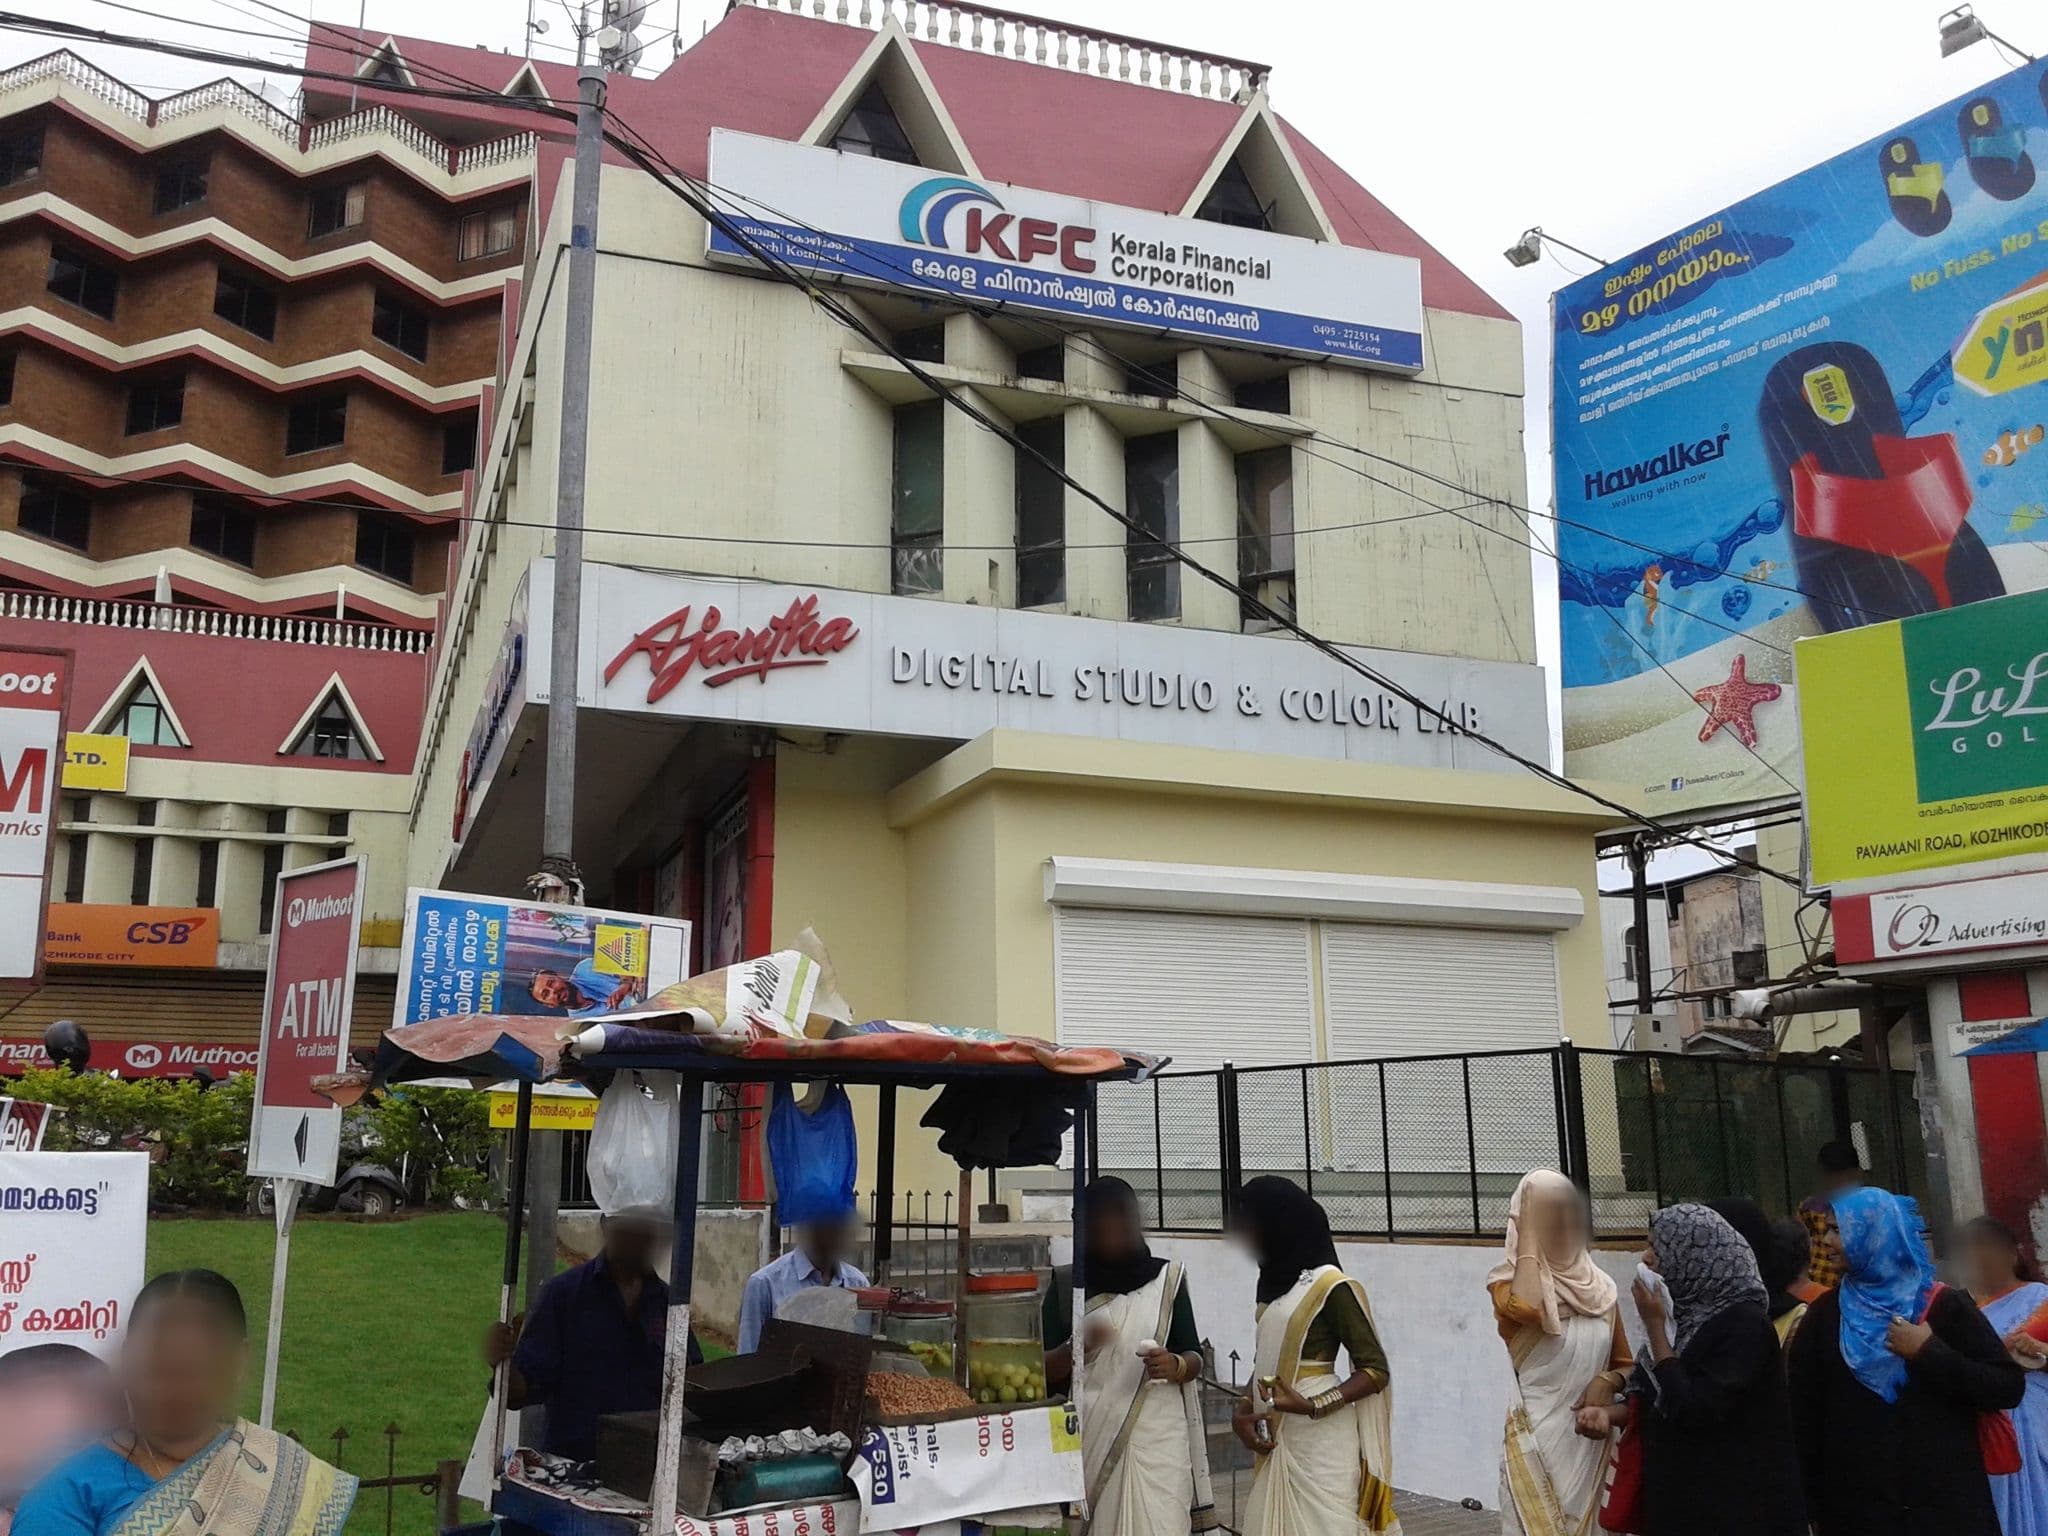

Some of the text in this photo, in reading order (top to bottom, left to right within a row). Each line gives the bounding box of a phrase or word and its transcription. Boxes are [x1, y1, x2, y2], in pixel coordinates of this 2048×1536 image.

[966, 207, 1097, 274] KFC
[1111, 233, 1271, 280] Kerala Financial
[1657, 220, 1723, 266] പോലെ
[912, 258, 977, 288] കേരള
[1111, 256, 1235, 296] Corporation
[1910, 271, 1940, 293] No
[2001, 231, 2033, 257] No
[1312, 325, 1335, 336] 0495
[1581, 303, 1620, 333] മഴ
[1324, 339, 1381, 355] www.kfc.org
[1982, 320, 2046, 380] yn
[1584, 433, 1730, 500] Hawalker
[1610, 471, 1707, 509] walking with now
[604, 593, 860, 704] Ajantha
[892, 645, 1483, 736] DIGITAL STUDIO & COLOR LAB
[1924, 652, 2048, 731] LuL
[1952, 726, 2036, 753] GOL
[64, 752, 107, 766] LTD.
[1856, 840, 1921, 859] PAVAMANI
[1925, 834, 1966, 851] ROAD,
[305, 892, 354, 923] Muthoot
[47, 922, 192, 945] Bank CSB
[1948, 916, 2046, 942] Advertising
[45, 951, 136, 961] ZHIKODE CITY
[622, 931, 632, 971] Asianet
[277, 977, 342, 1040] ATM
[168, 1045, 258, 1065] Muthoo
[296, 1042, 337, 1058] For all banks
[22, 1300, 118, 1339] കമ്മിറ്റി
